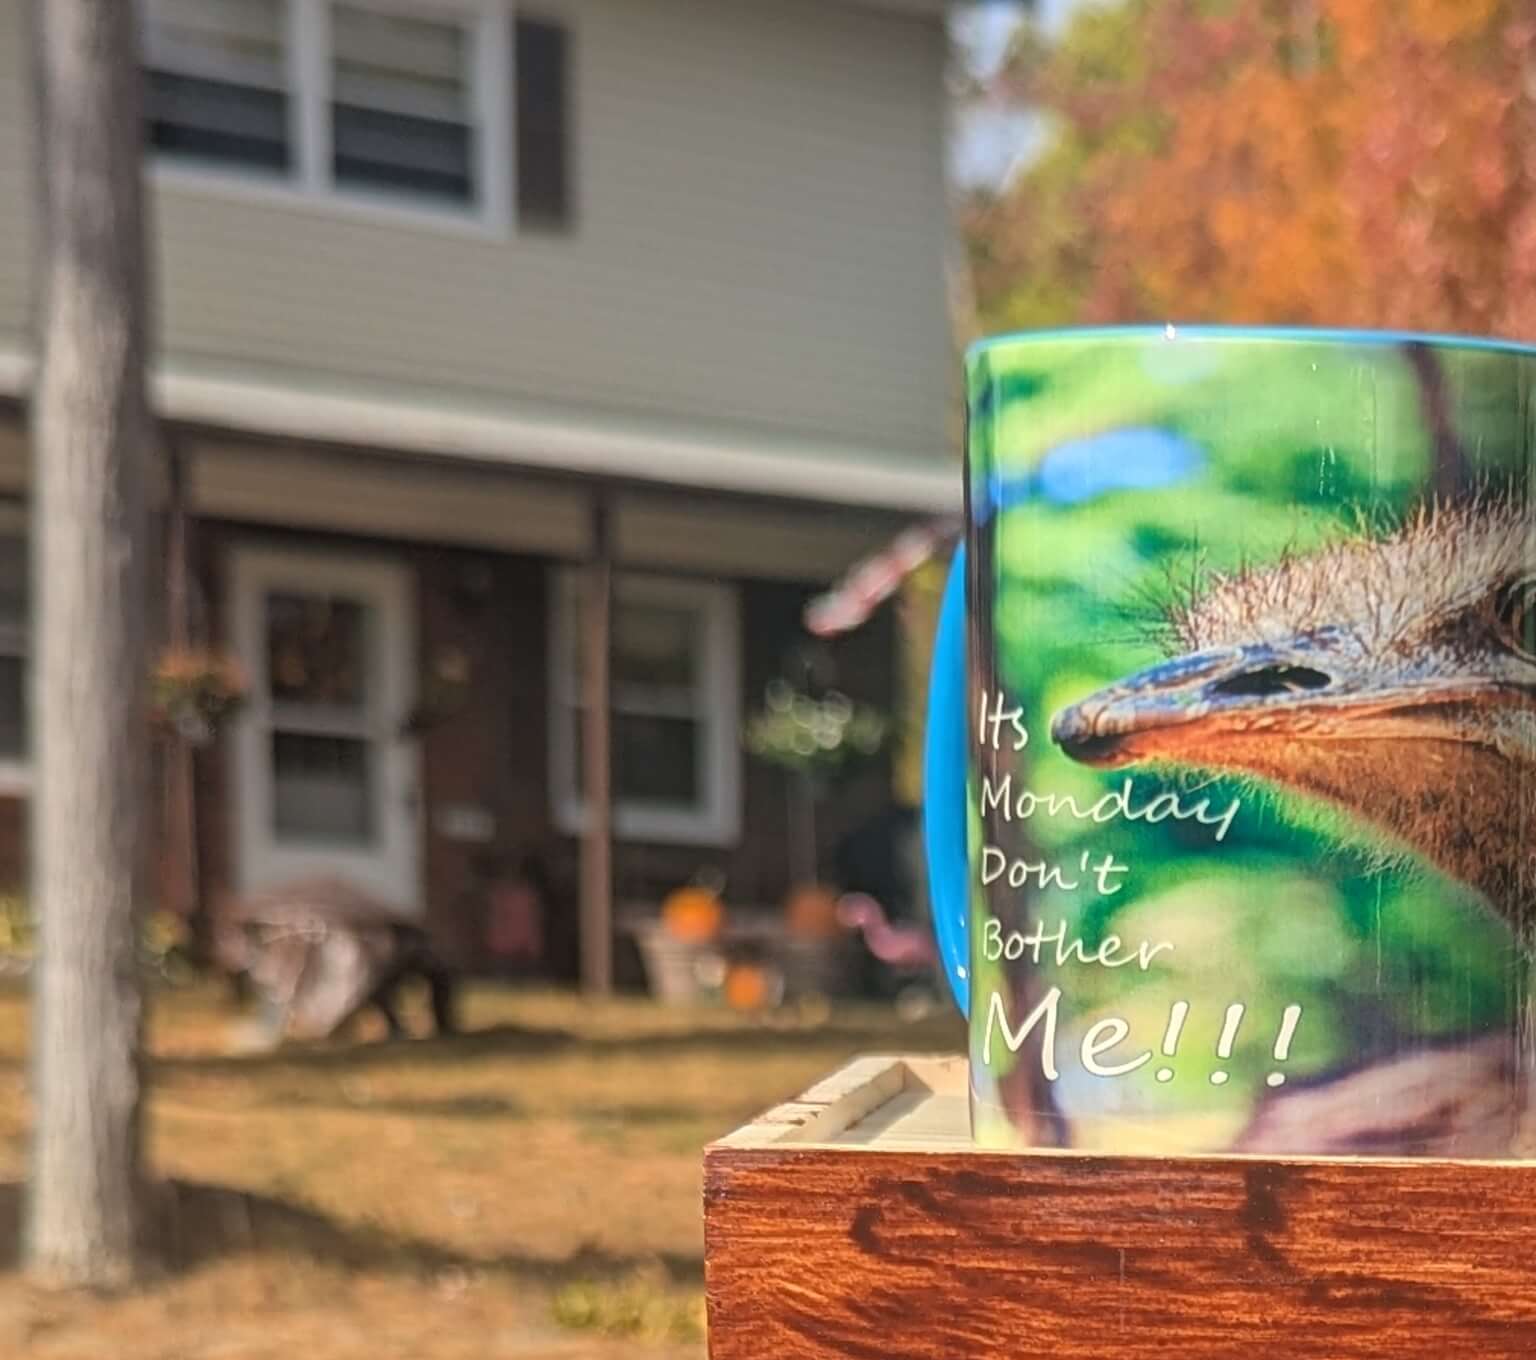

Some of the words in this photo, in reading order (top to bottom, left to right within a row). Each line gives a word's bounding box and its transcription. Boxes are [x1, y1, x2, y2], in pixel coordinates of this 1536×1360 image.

[978, 691, 1028, 751] Its
[980, 776, 1240, 841] Monday
[981, 846, 1128, 895] Don't
[982, 918, 1175, 970] Bother
[982, 986, 1301, 1087] Me!!!
